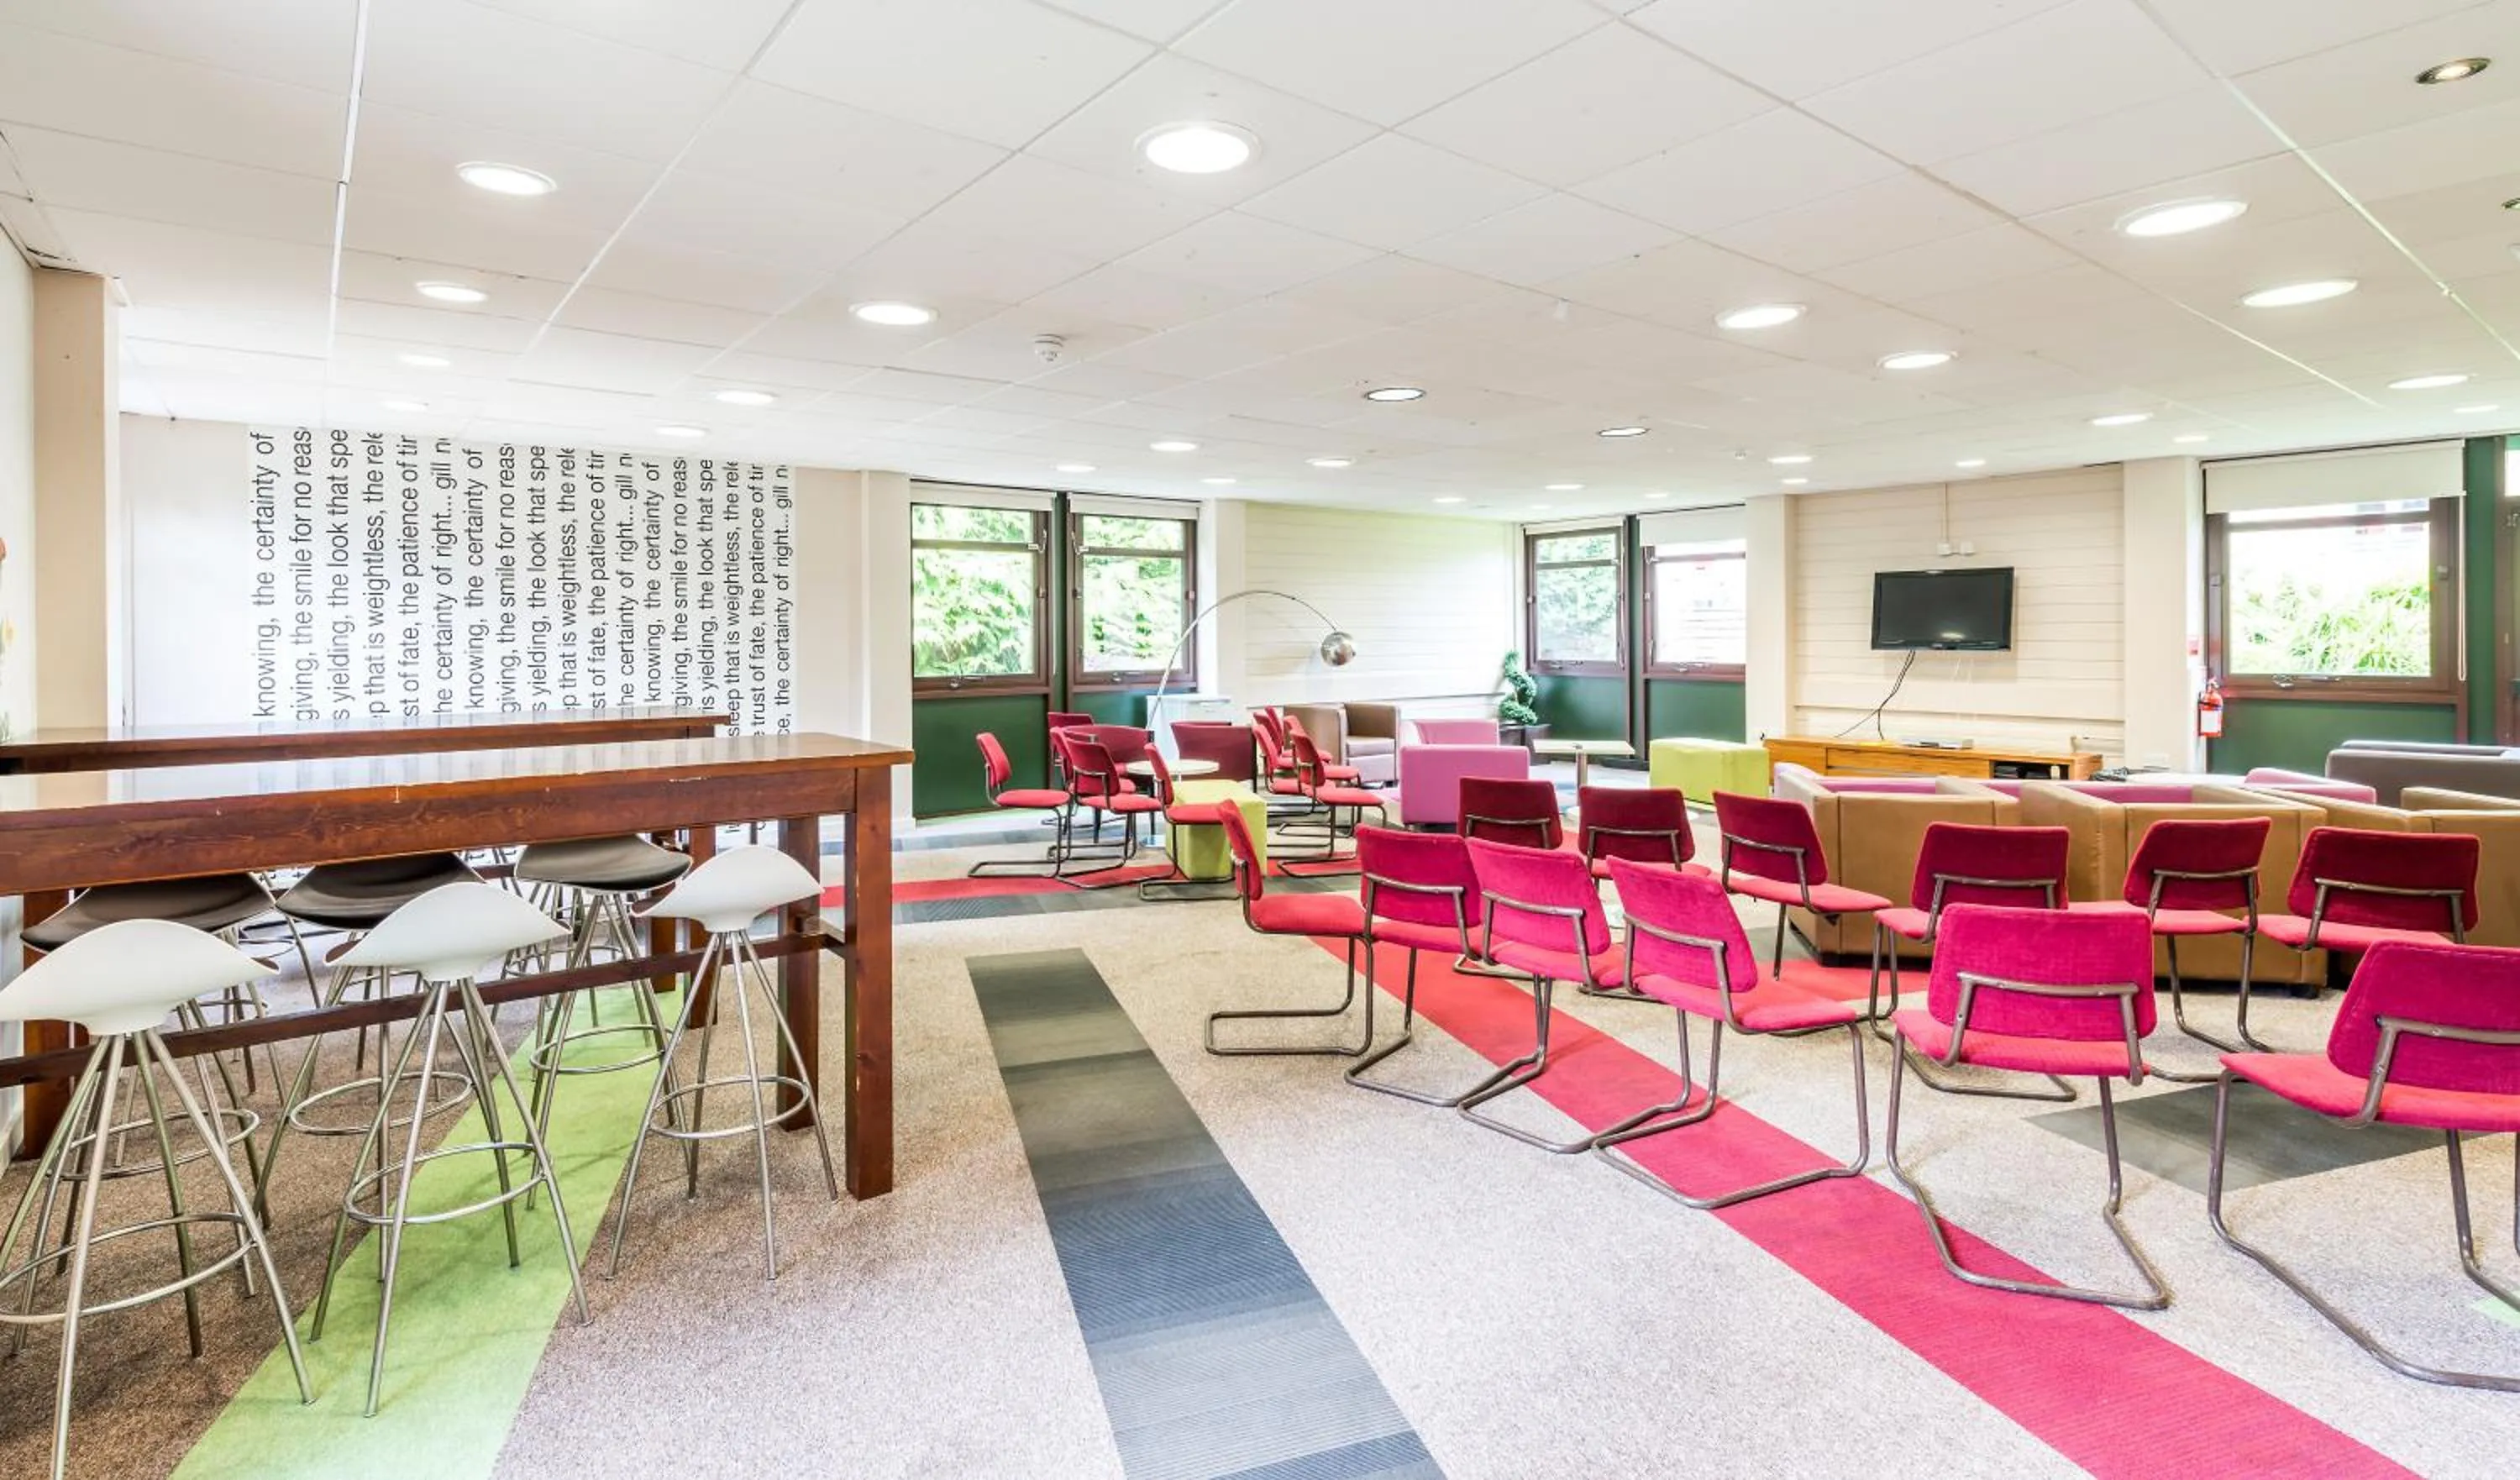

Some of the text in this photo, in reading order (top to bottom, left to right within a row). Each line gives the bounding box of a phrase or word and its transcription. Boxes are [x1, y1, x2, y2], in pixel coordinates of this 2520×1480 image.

[331, 429, 354, 469] spe
[435, 438, 451, 454] n
[531, 445, 550, 481] spe
[619, 453, 633, 467] n
[361, 470, 384, 504] the
[396, 460, 419, 482] of
[430, 462, 458, 491] gill
[585, 473, 606, 493] of
[614, 475, 638, 500] gill
[775, 464, 788, 479] n
[326, 474, 349, 517] that
[526, 486, 546, 525] that
[556, 481, 578, 513] the
[722, 492, 740, 521] the
[746, 485, 764, 504] of
[773, 485, 793, 509] gill
[326, 522, 349, 567] look
[396, 487, 424, 577] patience
[585, 498, 611, 580] patience
[746, 506, 770, 584] patience
[362, 510, 390, 627] weightless,
[526, 531, 548, 572] look
[250, 432, 281, 716] knowing, the certainty of
[289, 427, 319, 721] giving, the smile for no reas
[327, 574, 349, 607] the
[431, 564, 453, 585] of
[462, 449, 490, 708] knowing, the certainty of
[495, 443, 522, 714] giving, the smile for no reas
[554, 518, 582, 627] weightless,
[615, 569, 635, 589] of
[641, 462, 667, 702] knowing, the certainty of
[669, 457, 693, 707] giving, the smile for no reas
[696, 459, 720, 712] is yielding, the look that spe
[722, 527, 745, 627] weightless,
[772, 573, 789, 591] of
[397, 582, 419, 615] the
[527, 577, 549, 610] the
[587, 585, 606, 616] the
[746, 587, 765, 617] the
[363, 632, 385, 648] is
[398, 622, 422, 667] fate,
[432, 593, 458, 680] certainty
[558, 632, 577, 647] is
[587, 622, 609, 663] fate,
[616, 596, 639, 676] certainty
[723, 631, 740, 647] is
[748, 622, 770, 660] fate,
[772, 596, 793, 673] certainty
[327, 616, 355, 702] yielding,
[528, 616, 552, 696] yielding,
[558, 652, 577, 689] that
[723, 649, 740, 685] that
[748, 664, 765, 682] of
[363, 655, 385, 695] that
[398, 672, 419, 691] of
[587, 668, 606, 686] of
[774, 679, 790, 706] the
[750, 686, 765, 727] trust
